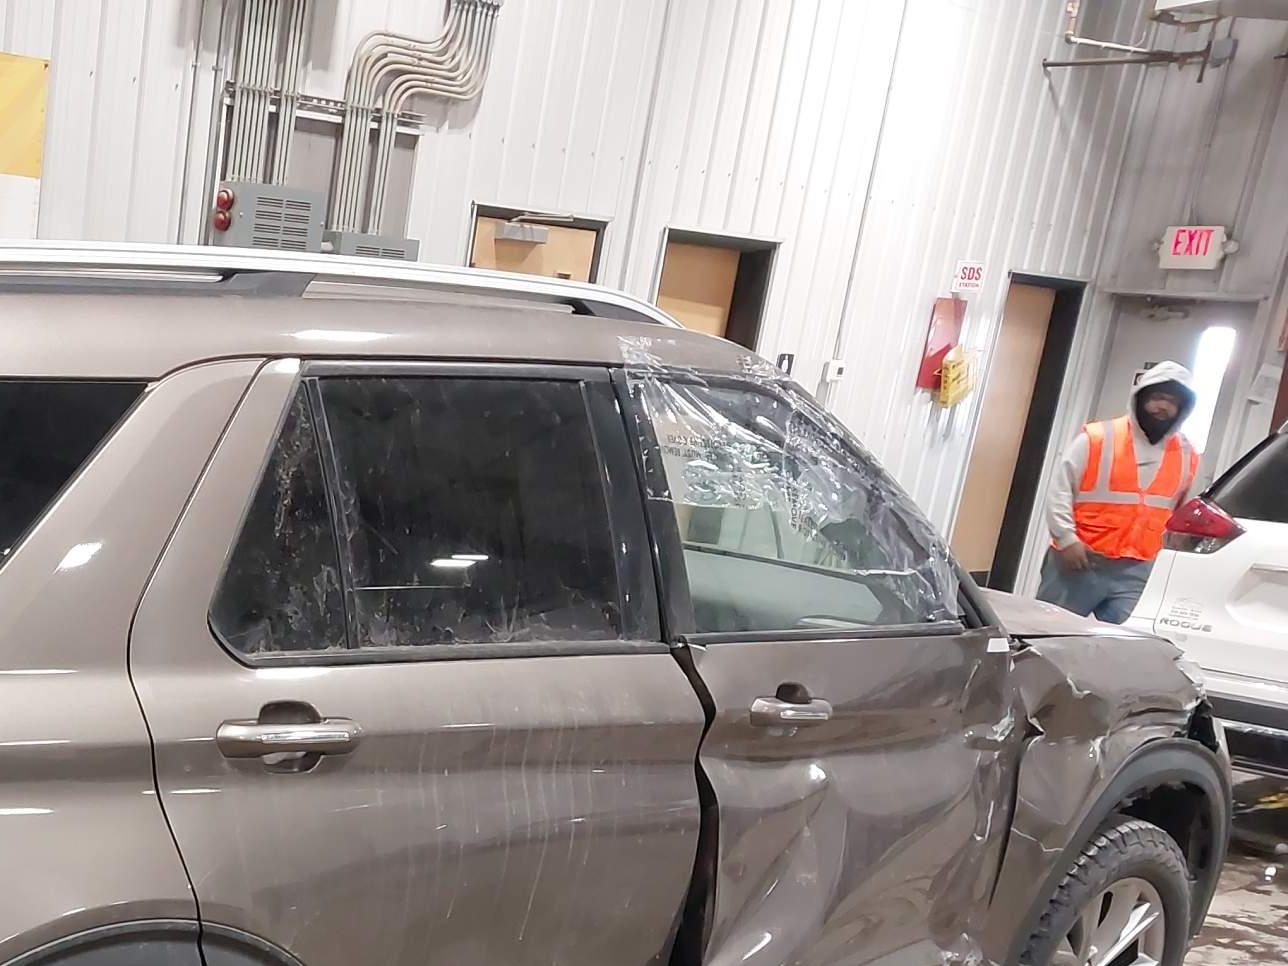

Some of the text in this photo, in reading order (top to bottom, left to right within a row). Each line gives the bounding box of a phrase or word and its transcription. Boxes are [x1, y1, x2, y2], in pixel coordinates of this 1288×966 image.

[1172, 229, 1215, 256] EXIT
[960, 266, 983, 281] SDS
[1159, 617, 1213, 633] ROGUE
